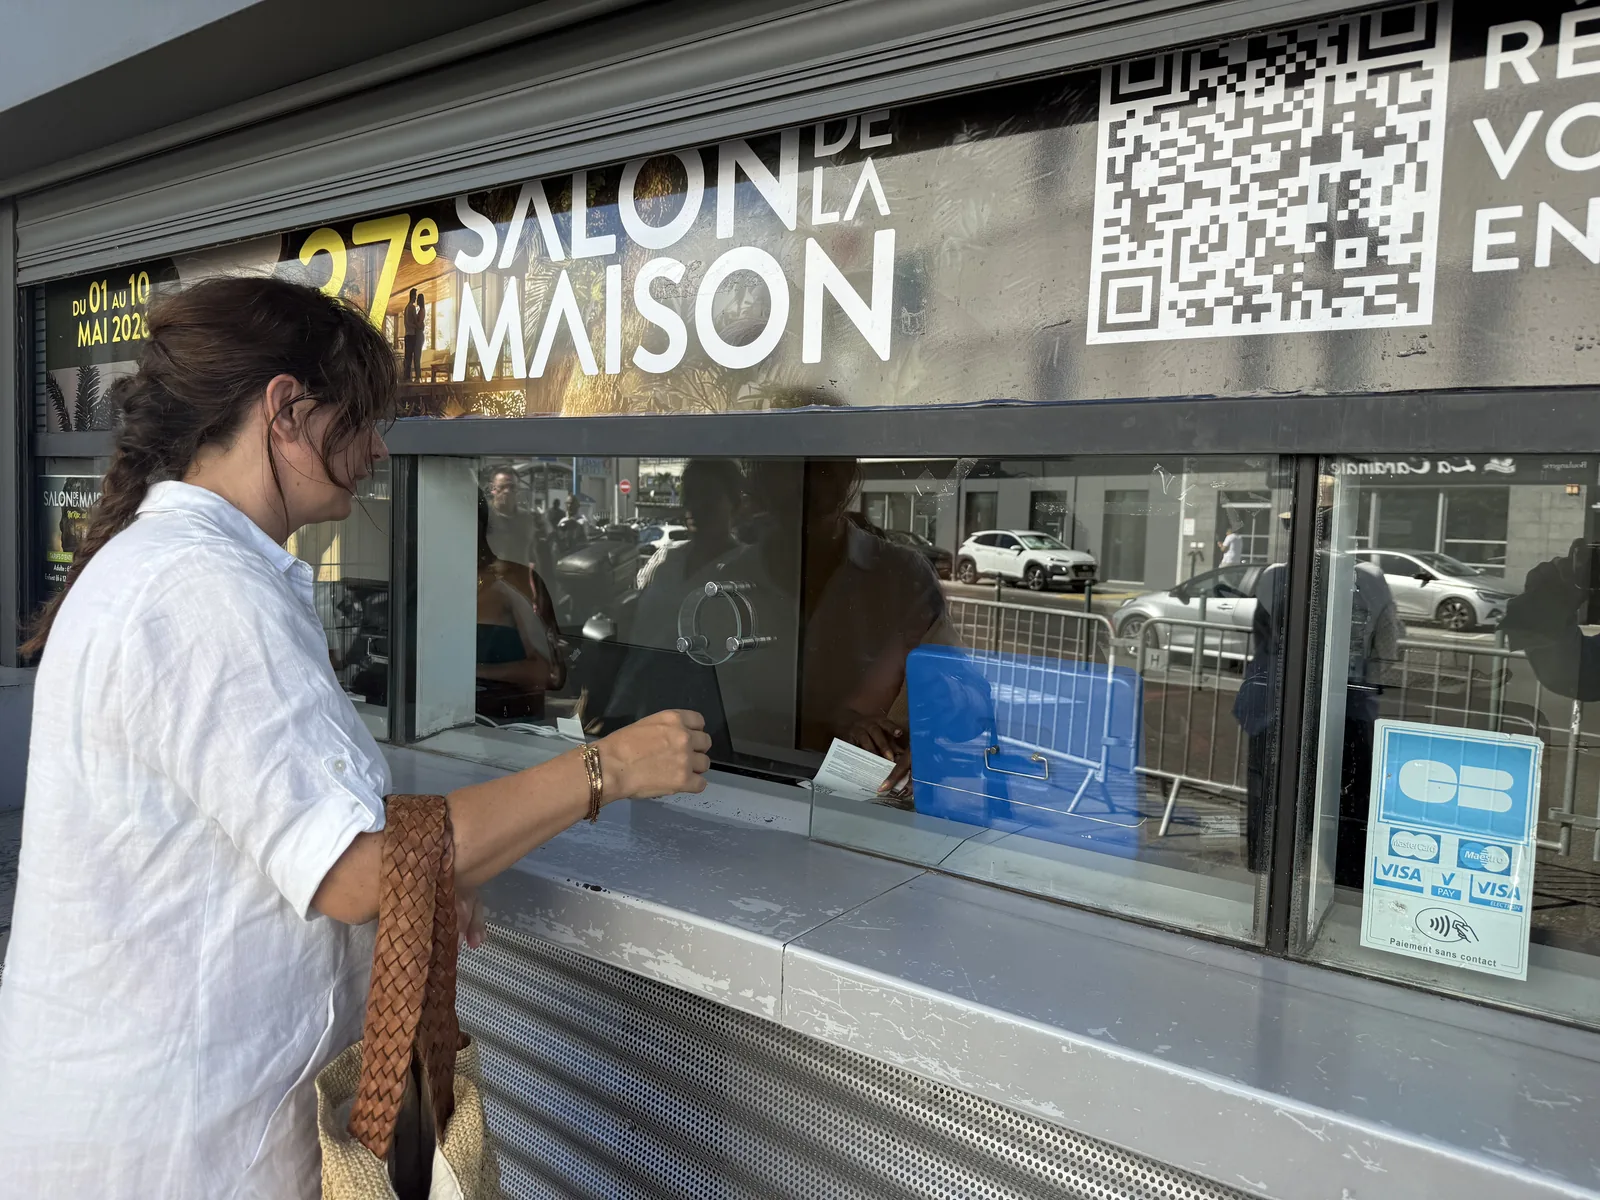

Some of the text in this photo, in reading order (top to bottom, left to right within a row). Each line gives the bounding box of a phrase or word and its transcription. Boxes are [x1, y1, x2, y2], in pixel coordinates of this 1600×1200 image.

[815, 109, 893, 158] DE
[454, 127, 799, 274] SALON
[812, 156, 891, 226] LA
[1472, 197, 1600, 272] EN
[72, 271, 150, 317] DU 01 AU 10
[452, 228, 896, 382] MAISON
[77, 317, 108, 348] MAI
[44, 490, 73, 507] SALON
[73, 491, 79, 500] DE
[1464, 850, 1503, 864] Maestro
[1381, 863, 1422, 882] VISA
[1437, 887, 1455, 896] PAY
[1477, 881, 1521, 901] VISA
[1390, 937, 1497, 967] Paiement sans contact
